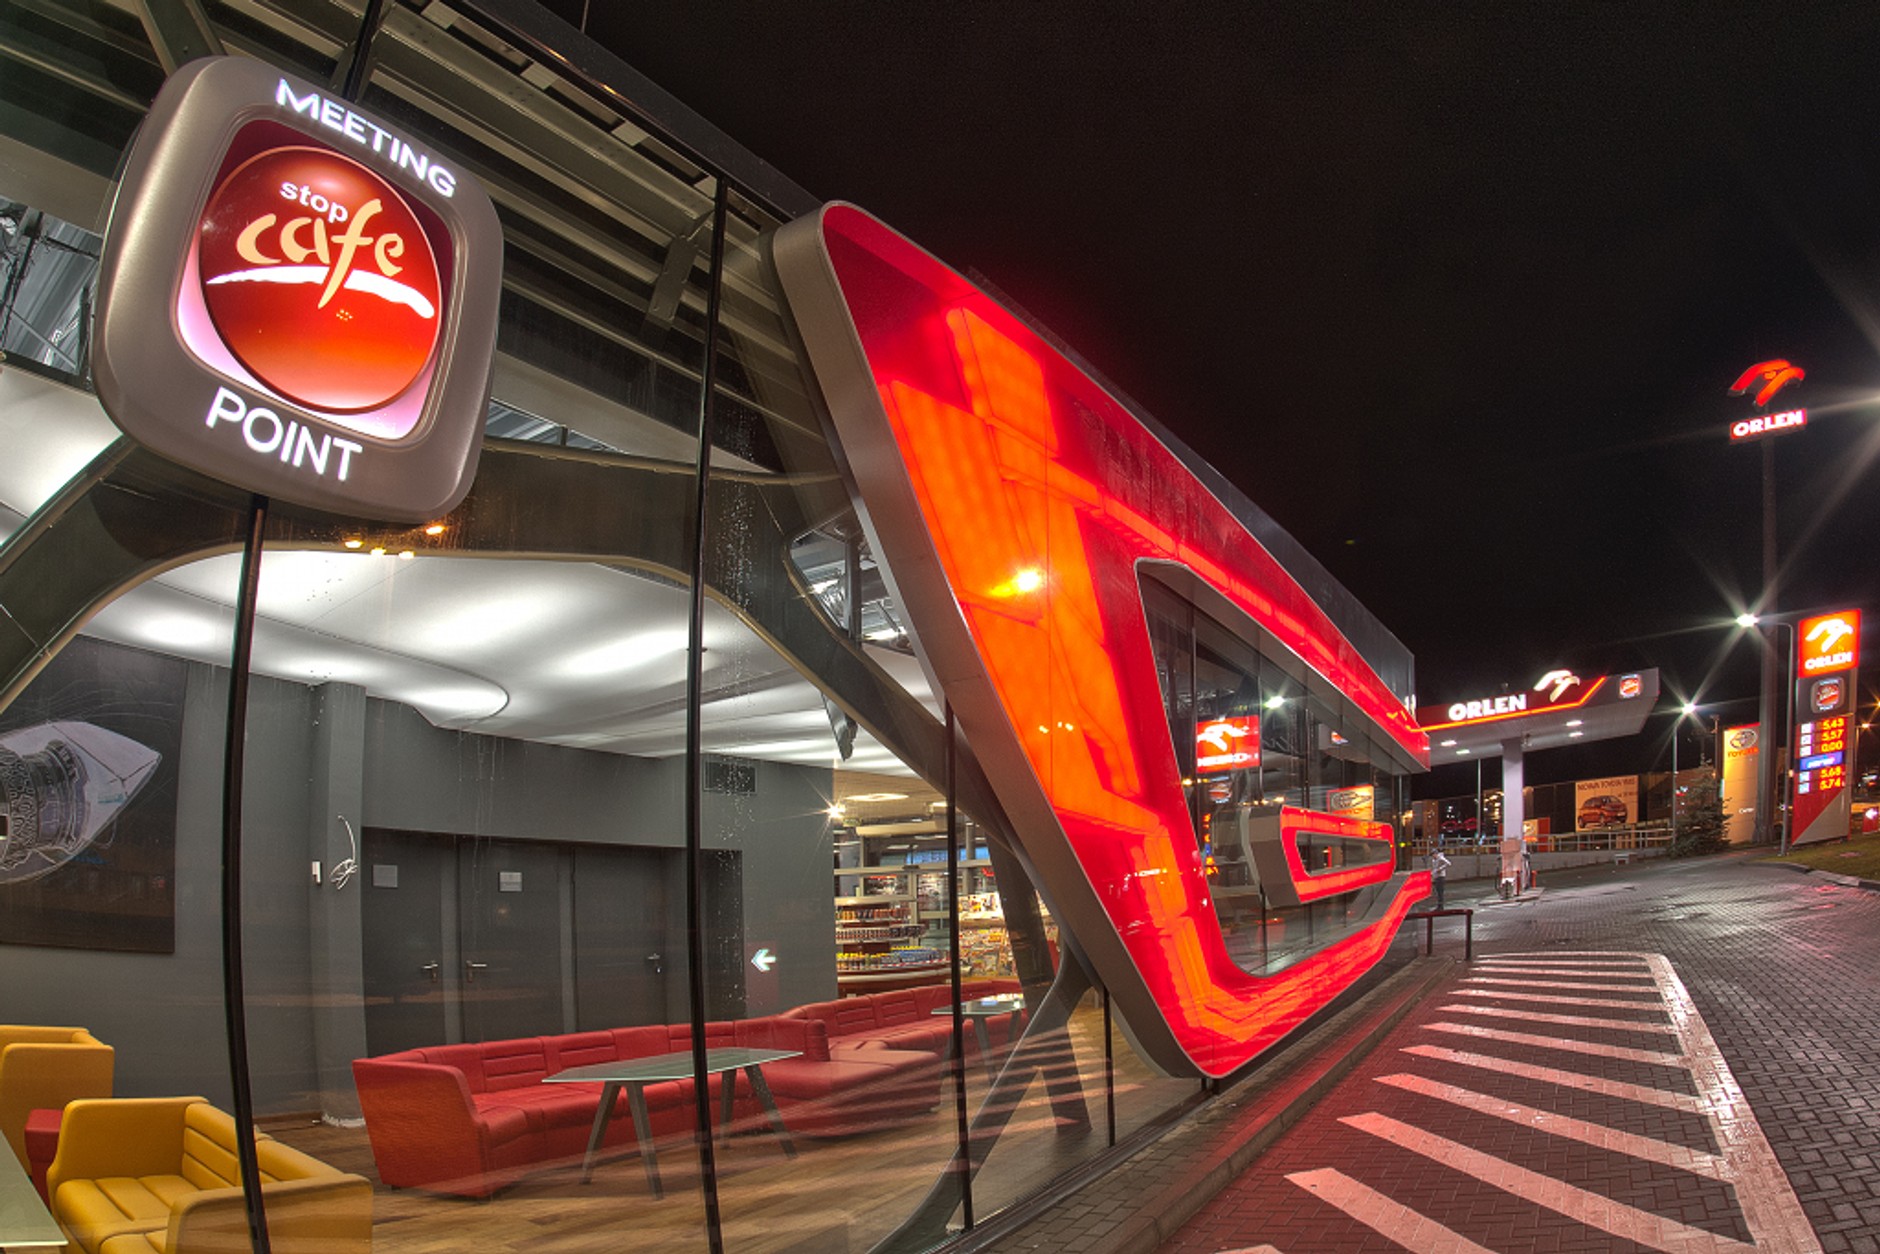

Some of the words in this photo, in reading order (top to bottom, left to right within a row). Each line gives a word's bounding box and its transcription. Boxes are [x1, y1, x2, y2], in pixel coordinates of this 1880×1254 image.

[276, 78, 456, 198] MEETING
[280, 182, 349, 223] stop
[236, 199, 404, 309] cafe
[205, 386, 363, 482] POINT
[1733, 410, 1804, 437] ORLEN
[1804, 651, 1853, 670] ORLEN
[1448, 694, 1527, 721] ORLEN
